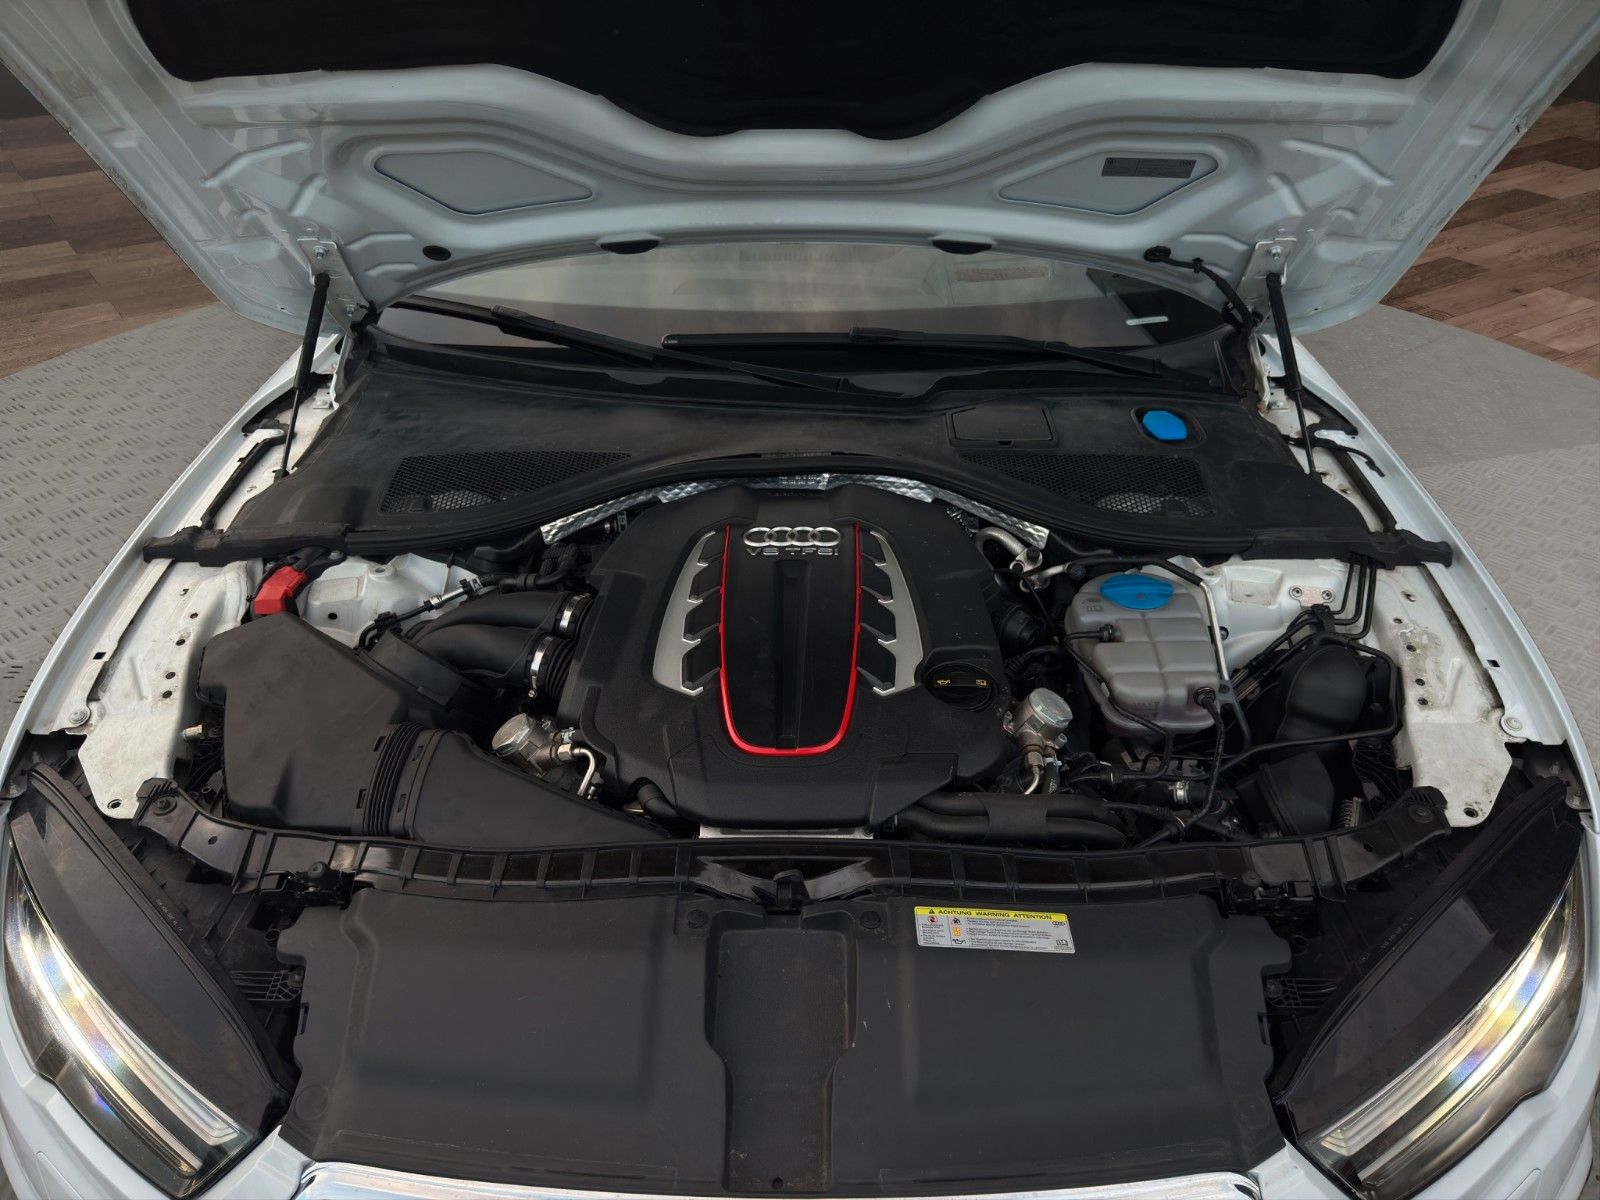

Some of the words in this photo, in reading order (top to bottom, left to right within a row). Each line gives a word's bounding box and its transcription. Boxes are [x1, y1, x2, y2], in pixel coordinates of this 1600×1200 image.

[938, 908, 972, 916] ACHTUNG
[976, 910, 1010, 918] WARNING
[1013, 912, 1052, 920] ATTENTION
